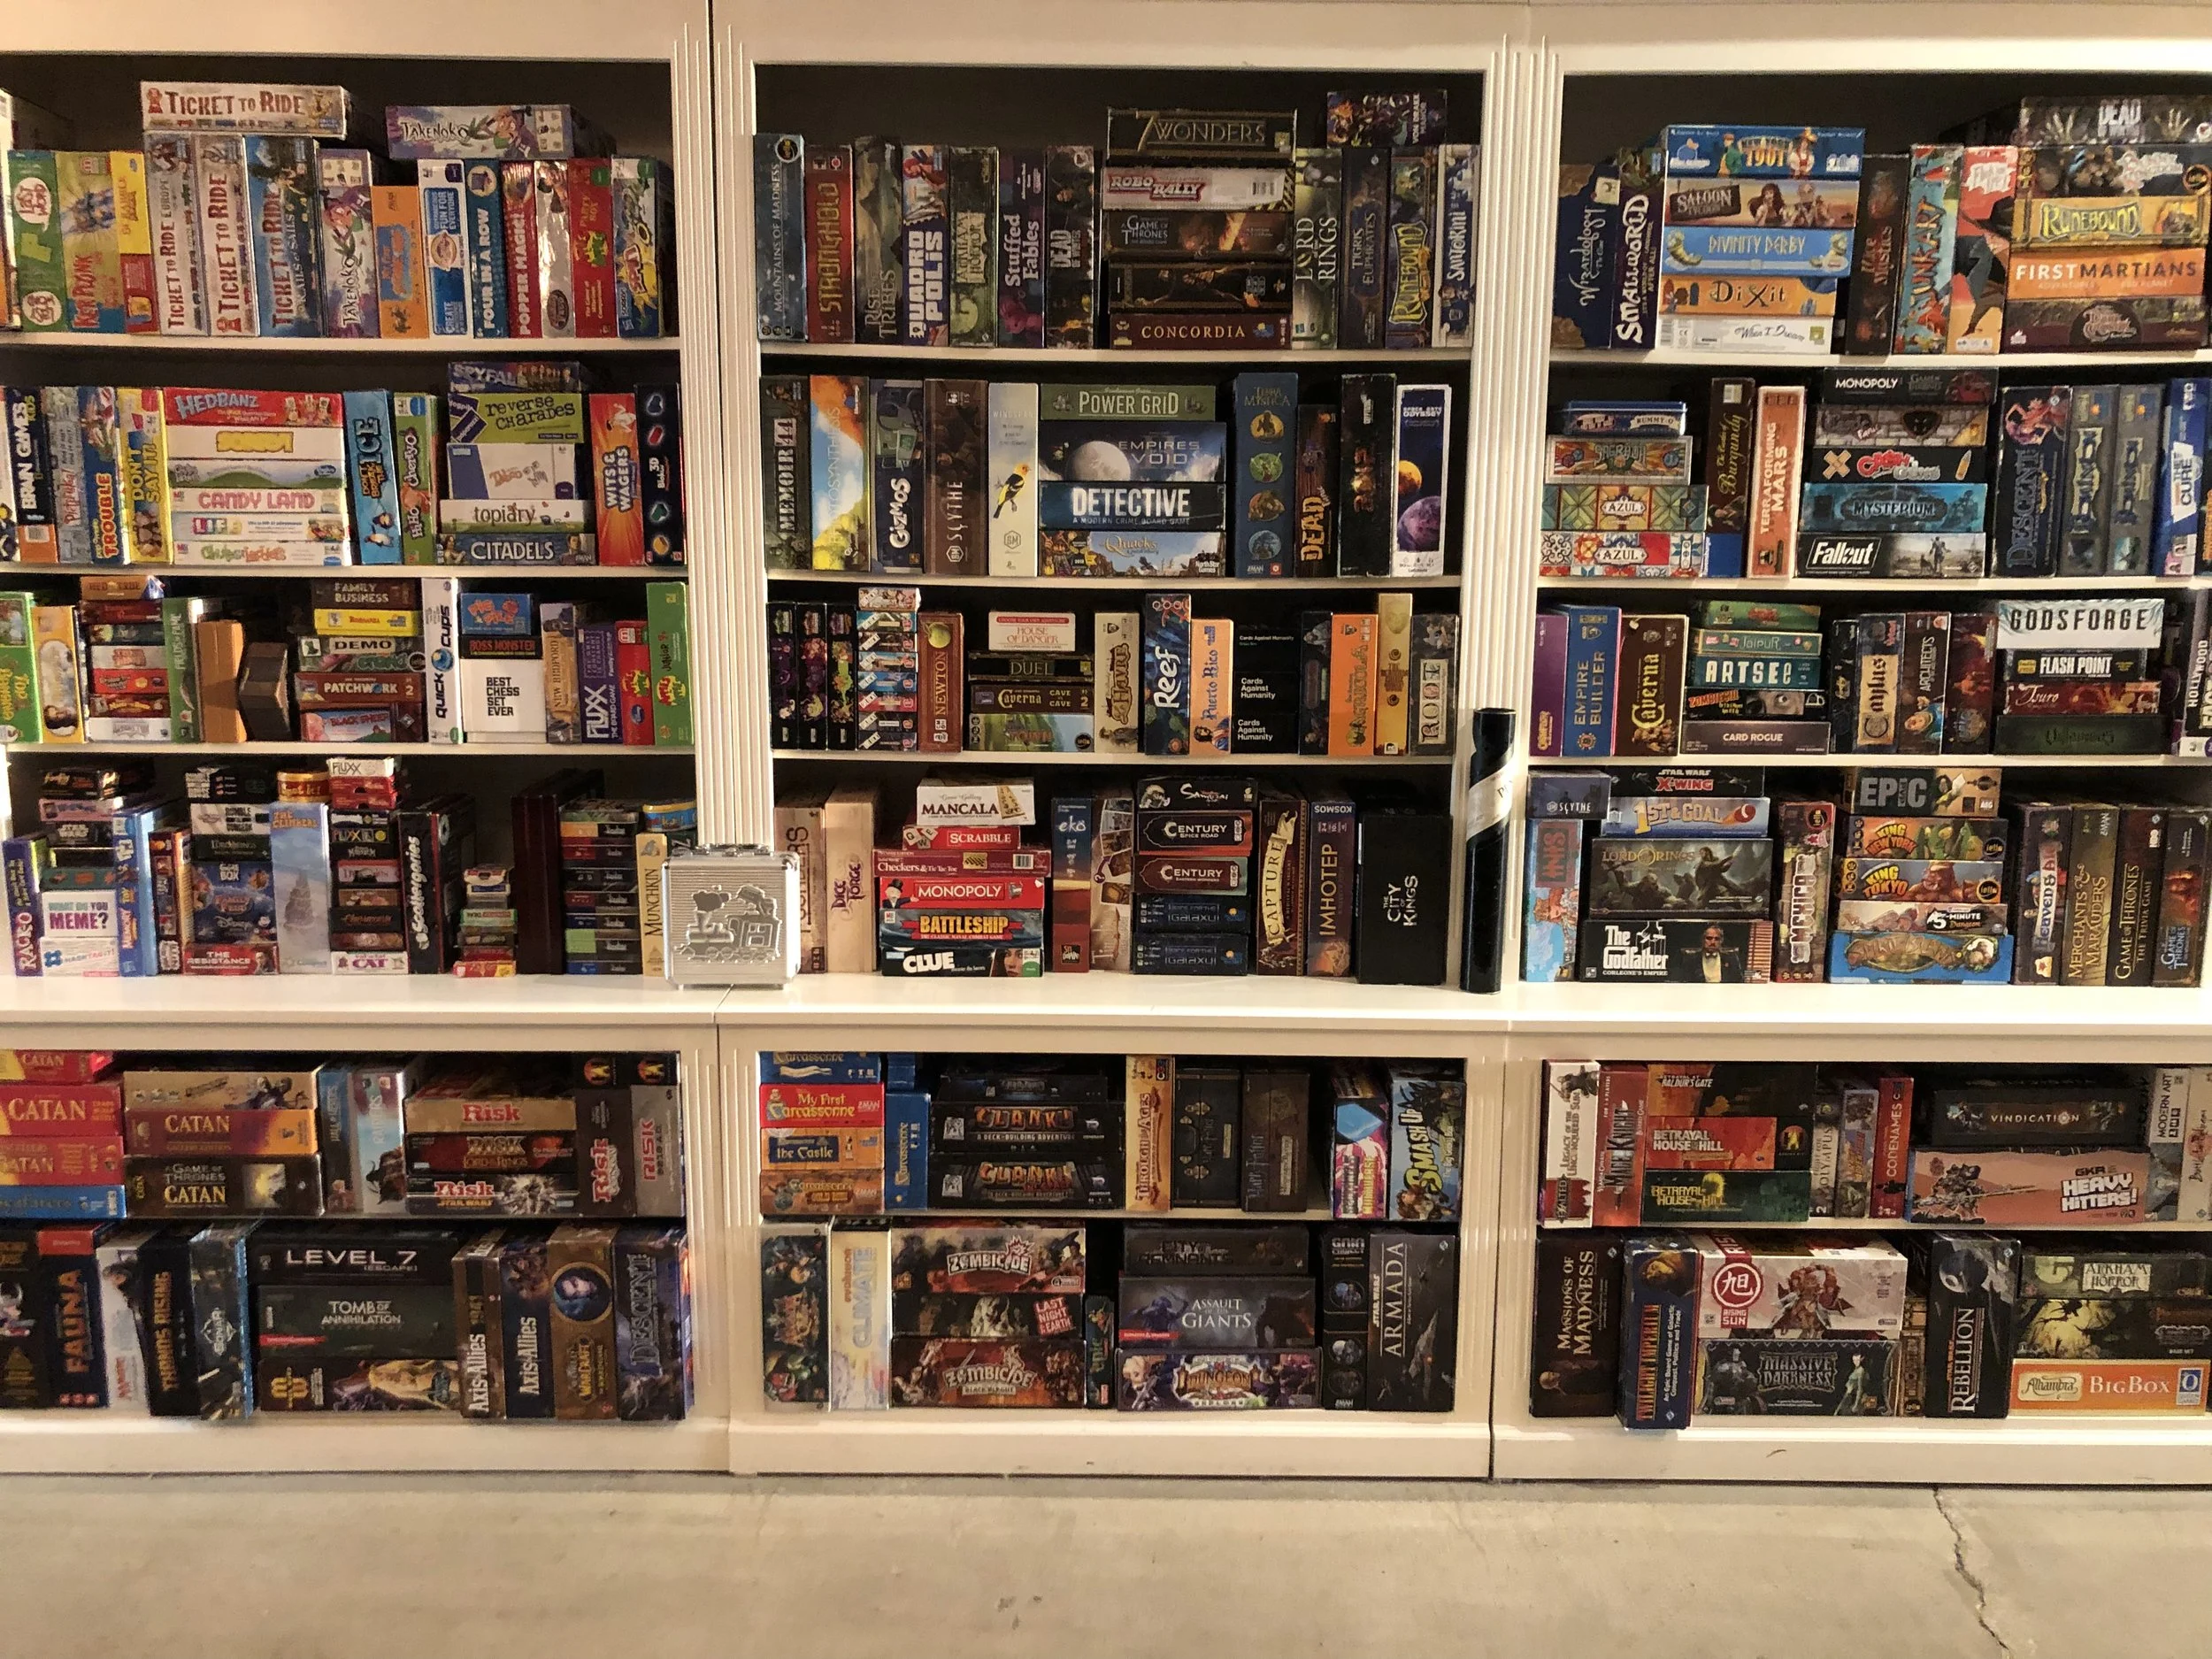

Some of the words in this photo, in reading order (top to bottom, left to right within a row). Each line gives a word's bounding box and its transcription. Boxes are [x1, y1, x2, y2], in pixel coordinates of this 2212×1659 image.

[165, 91, 234, 115] TICKET
[238, 97, 256, 111] TO
[259, 91, 305, 115] RIDE
[2098, 99, 2141, 120] DEAD
[770, 163, 780, 221] MADNESS
[1676, 188, 1732, 212] SALOON
[772, 224, 781, 242] OF
[515, 213, 529, 274] MAGIC!
[1003, 212, 1021, 288] Stuffed
[1021, 220, 1040, 280] Fables
[1050, 230, 1071, 268] DEAD
[1318, 217, 1338, 281] RINGS
[1709, 234, 1759, 255] DIVINITY
[1764, 234, 1807, 255] DERBY
[772, 246, 783, 312] MOUNTAINS
[2016, 265, 2076, 280] FIRST
[2079, 262, 2196, 279] MARTIANS
[518, 280, 531, 335] POPPER
[1141, 325, 1246, 339] CONCORDIA
[1835, 378, 1899, 389] MONOPOLY
[486, 396, 554, 418] reverse
[1079, 391, 1134, 414] POWER
[1141, 392, 1179, 414] GRID
[356, 418, 381, 465] ICE
[1118, 441, 1200, 450] EMPIRES
[1131, 453, 1188, 465] VOID
[617, 447, 633, 511] WAGERS
[1759, 422, 1777, 534] TERRAFORMING
[1772, 446, 1788, 512] MARS
[2180, 460, 2193, 506] CURE
[199, 492, 261, 510] CANDY
[266, 492, 315, 509] LAND
[946, 480, 964, 541] SCYTHE
[1072, 488, 1191, 517] DETECTIVE
[1608, 503, 1639, 513] AZUL
[1853, 501, 1936, 518] MYSTERIUM
[96, 472, 119, 559] TROUBLE
[474, 503, 536, 524] topiary
[1302, 496, 1325, 561] DEAD
[470, 541, 554, 562] CITADELS
[1602, 550, 1638, 562] AZUL
[1812, 541, 1875, 565] Fallout
[334, 582, 375, 593] FAMILY
[334, 593, 389, 603] BUSINESS
[2009, 608, 2148, 632] GODSFORGE
[334, 640, 392, 650] DEMO
[1010, 662, 1055, 676] DUEL
[2039, 655, 2075, 675] FLASH
[2078, 655, 2113, 675] POINT
[2187, 640, 2208, 708] HOLLYWOOD
[487, 677, 512, 687] BEST
[935, 652, 947, 716] NEWTON
[1154, 646, 1181, 709] Reef
[487, 687, 520, 696] CHESS
[1575, 659, 1589, 726] EMPIRE
[1590, 650, 1606, 726] BUILDER
[487, 696, 505, 706] SET
[1421, 662, 1440, 741] ROOT
[488, 707, 514, 717] EVER
[1723, 733, 1748, 742] CARD
[1750, 733, 1783, 742] ROGUE
[332, 762, 361, 775] FLUXX
[921, 803, 999, 815] MANCALA
[1314, 805, 1353, 814] KOSMOS
[949, 832, 1011, 844] SCRABBLE
[1164, 822, 1227, 837] CENTURY
[1160, 865, 1224, 879] CENTURY
[918, 885, 1002, 897] MONOPOLY
[1263, 842, 1283, 937] CAPTURE
[1319, 843, 1339, 936] IMHOTEP
[1863, 880, 1908, 897] TOKYO
[643, 868, 663, 938] MUNCHKIN
[1386, 883, 1402, 923] CITY
[1402, 875, 1419, 926] KINGS
[50, 912, 109, 930] MEME?
[920, 916, 1009, 933] BATTLESHIP
[2086, 876, 2108, 966] MARAUDERS
[1605, 926, 1631, 946] The
[352, 958, 381, 968] CAT
[902, 951, 956, 972] CLUE
[1602, 946, 1669, 971] Godfather
[1662, 1078, 1694, 1087] BALDUR'S
[1694, 1078, 1714, 1087] GATE
[2163, 1073, 2174, 1094] ART
[798, 1093, 817, 1105] My
[819, 1093, 846, 1105] First
[9, 1098, 86, 1121] CATAN
[462, 1103, 520, 1123] Risk
[766, 1103, 856, 1120] Carcassonne
[2158, 1095, 2170, 1138] MODERN
[165, 1115, 231, 1133] CATAN
[1653, 1130, 1710, 1141] BETRAYAL
[1886, 1102, 1902, 1177] CODENAMES
[777, 1145, 795, 1159] the
[797, 1146, 833, 1159] Castle
[164, 1173, 226, 1182] THRONES
[2062, 1173, 2133, 1196] HEAVY
[164, 1186, 227, 1203] CATAN
[434, 1181, 495, 1196] Risk
[1651, 1186, 1704, 1197] BETRAYAL
[287, 1249, 390, 1265] LEVEL
[394, 1251, 417, 1265] 7
[947, 1250, 1033, 1275] ZOMBICIDE
[1563, 1256, 1573, 1276] OF
[1722, 1271, 1753, 1298] 旭
[328, 1301, 374, 1314] TOMB
[377, 1301, 392, 1310] OF
[1036, 1297, 1064, 1312] LAST
[1191, 1298, 1242, 1311] ASSAULT
[1383, 1241, 1404, 1358] ARMADA
[1573, 1250, 1595, 1356] MADNESS
[322, 1314, 401, 1325] ANNIHILATION
[627, 1254, 660, 1366] DESCENT
[1038, 1310, 1068, 1324] NIGHT
[1557, 1279, 1573, 1350] MANSIONS
[58, 1270, 88, 1372] FAUNA
[1182, 1312, 1251, 1329] GIANTS
[1722, 1316, 1747, 1325] SUN
[1764, 1356, 1832, 1371] MASSIVE
[1951, 1308, 1976, 1413] REBELLION
[1663, 1379, 1672, 1392] Epic
[1763, 1371, 1833, 1386] DARKNESS
[1663, 1393, 1671, 1402] An
